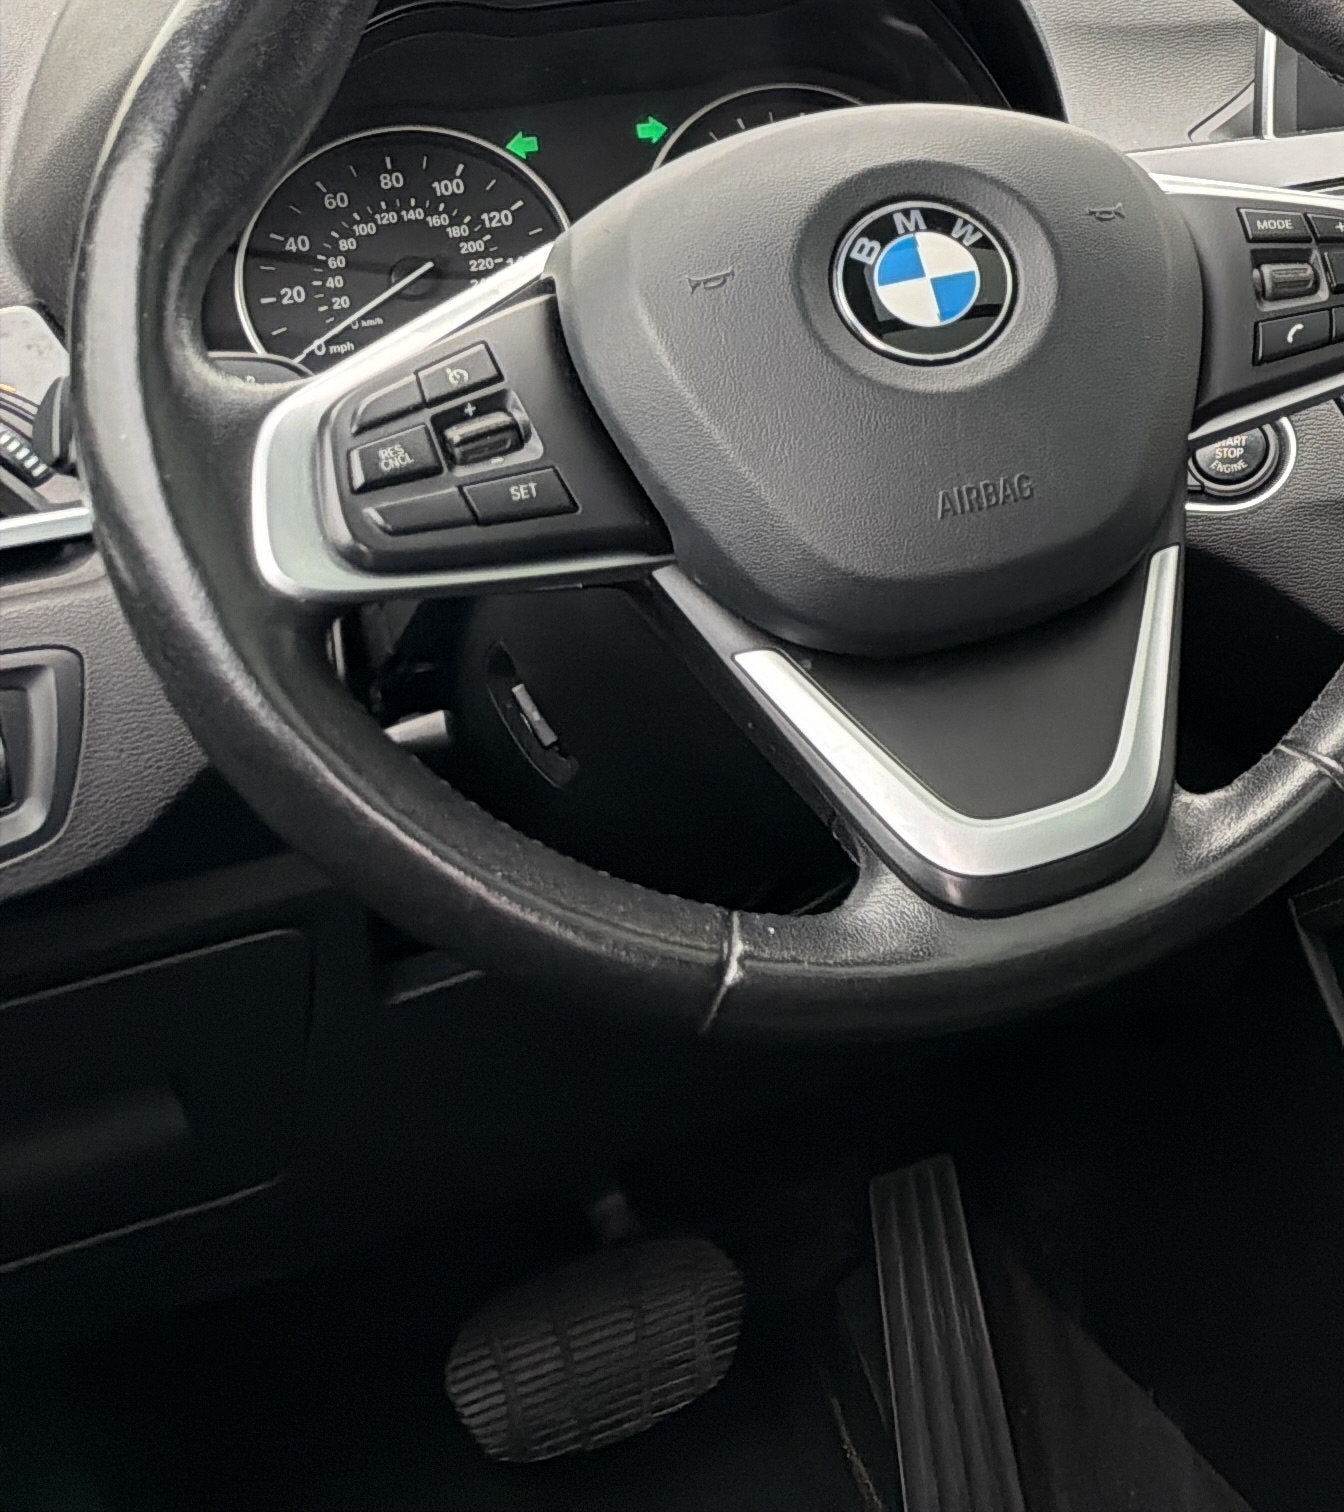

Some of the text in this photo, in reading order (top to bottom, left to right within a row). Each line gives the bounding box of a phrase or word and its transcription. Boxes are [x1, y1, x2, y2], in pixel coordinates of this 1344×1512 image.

[379, 172, 405, 189] 80
[432, 178, 465, 197] 100
[324, 192, 349, 210] 60
[374, 211, 398, 225] 120
[400, 208, 425, 222] 140
[426, 213, 450, 228] 160
[480, 209, 514, 229] 120
[352, 222, 377, 237] 100
[445, 225, 470, 239] 180
[1256, 219, 1294, 231] MODE
[284, 235, 311, 253] 40
[338, 237, 357, 251] 80
[850, 209, 983, 265] BMW
[459, 239, 485, 255] 200
[327, 255, 346, 269] 60
[468, 257, 495, 272] 220
[325, 275, 344, 289] 40
[280, 285, 306, 305] 20
[332, 296, 350, 310] 20
[313, 339, 355, 357] 0 mph
[378, 444, 406, 461] RES
[1215, 446, 1244, 459] STOP
[379, 453, 416, 473] CNCL
[1209, 459, 1249, 475] ENGINE
[508, 482, 538, 502] SET
[937, 472, 1035, 520] AIRBAG
